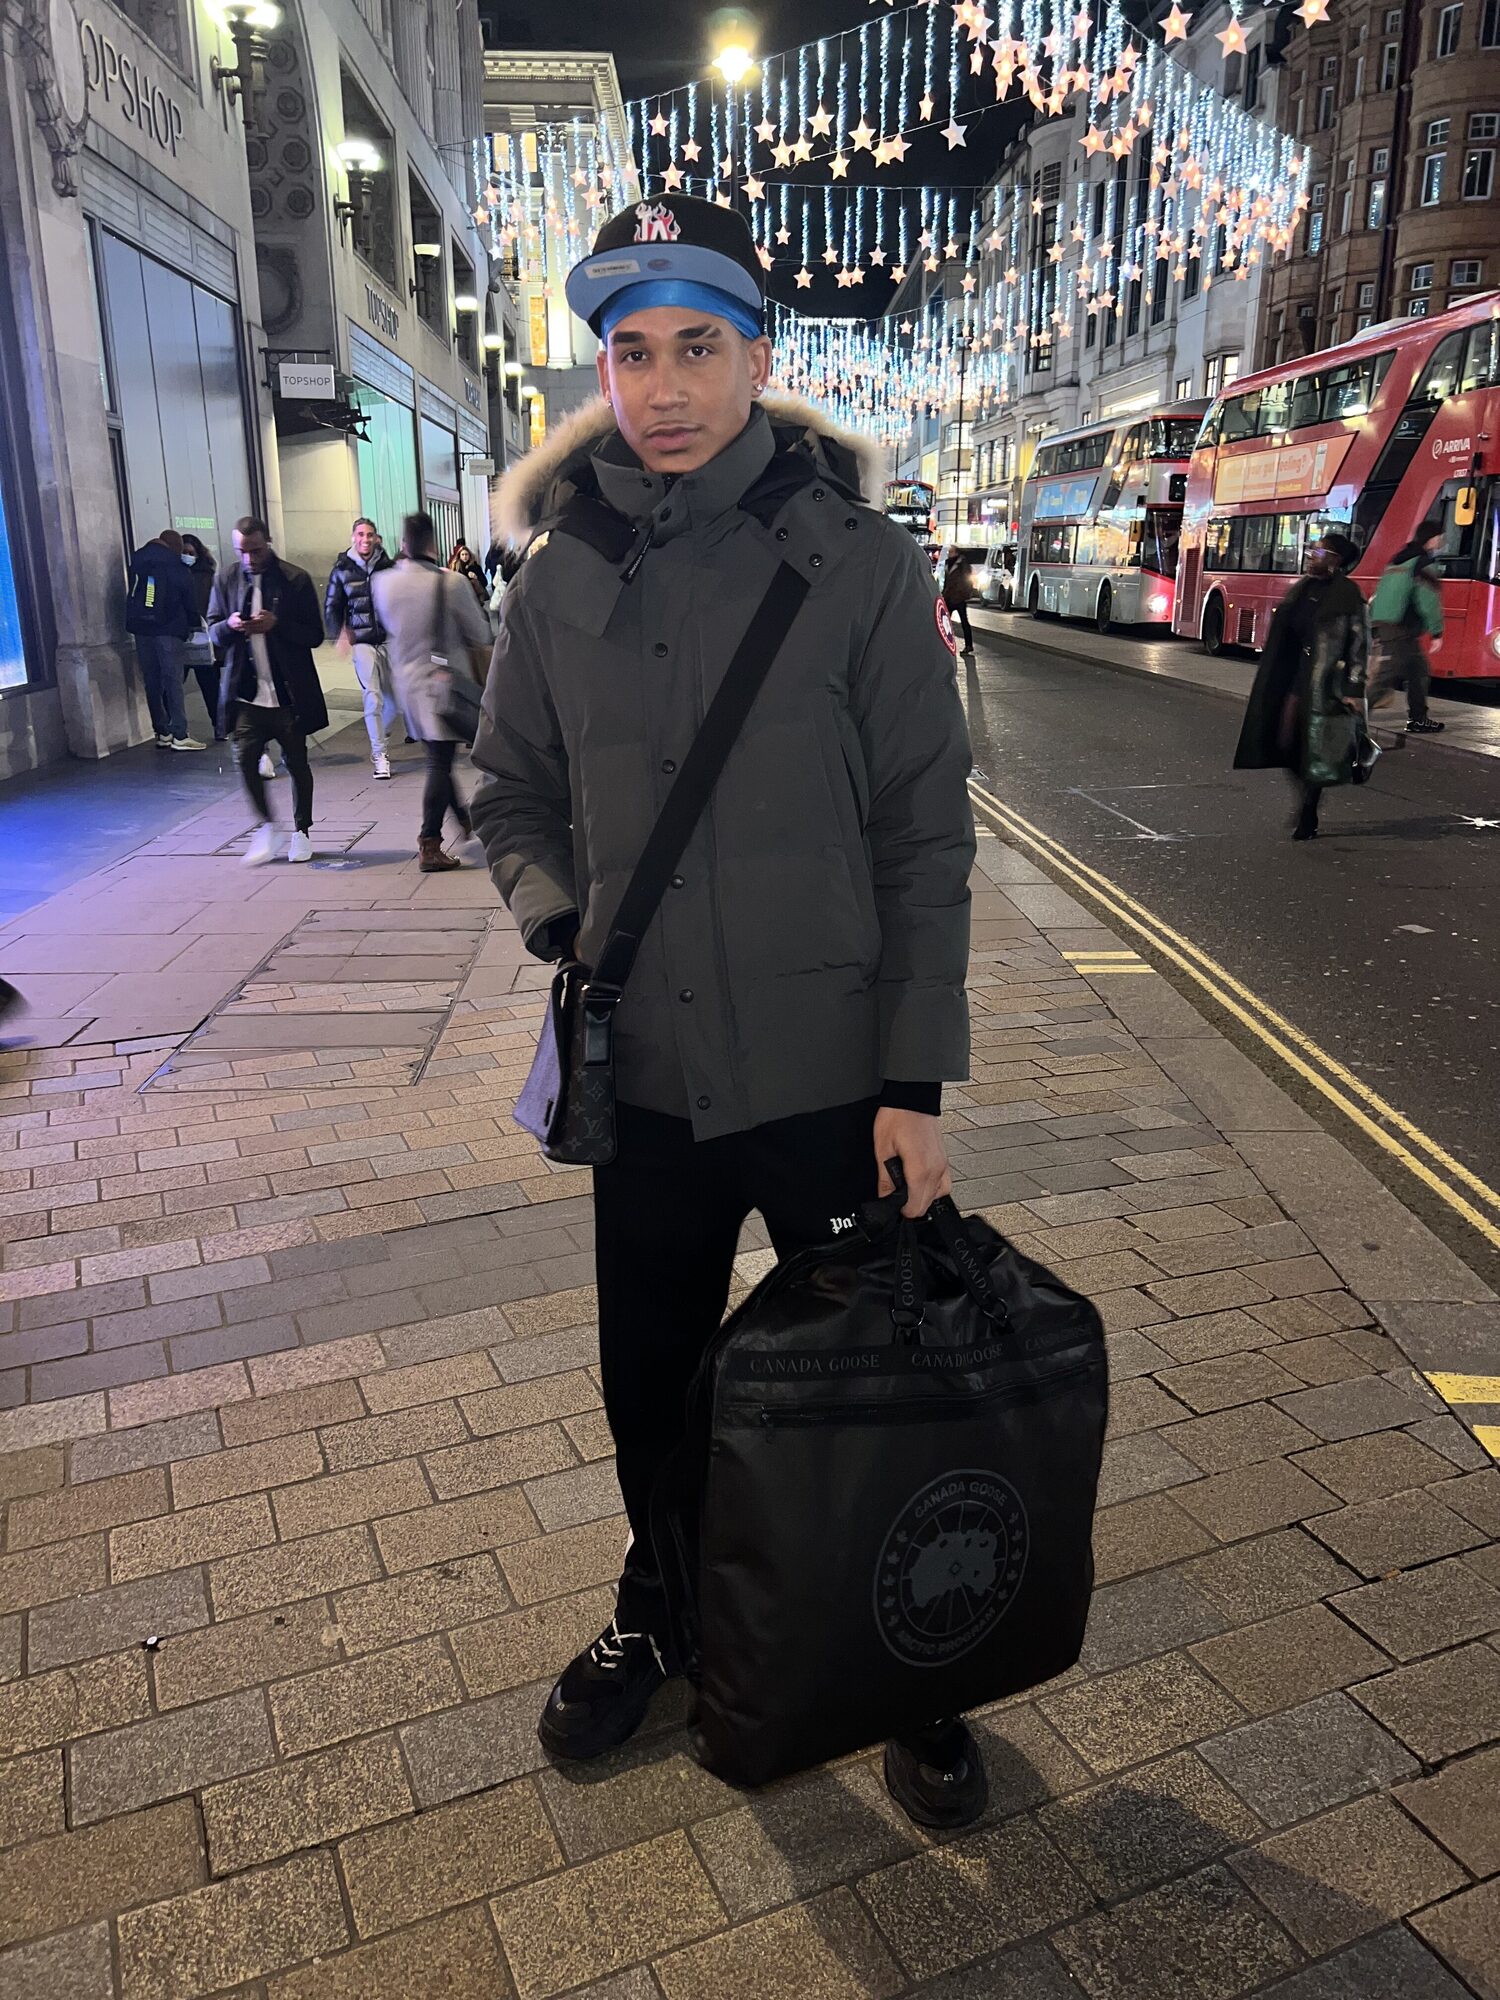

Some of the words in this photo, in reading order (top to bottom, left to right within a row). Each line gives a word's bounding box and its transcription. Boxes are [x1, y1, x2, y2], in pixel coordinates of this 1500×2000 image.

[81, 19, 184, 157] OPSHOP
[283, 375, 331, 386] TOPSHOP
[1442, 438, 1471, 454] ARRIVA
[900, 1247, 914, 1306] GOOSE
[750, 1357, 822, 1374] CANADA
[829, 1354, 880, 1371] GOOSE
[914, 1481, 966, 1518] CANADA
[969, 1481, 1009, 1507] GOOSE
